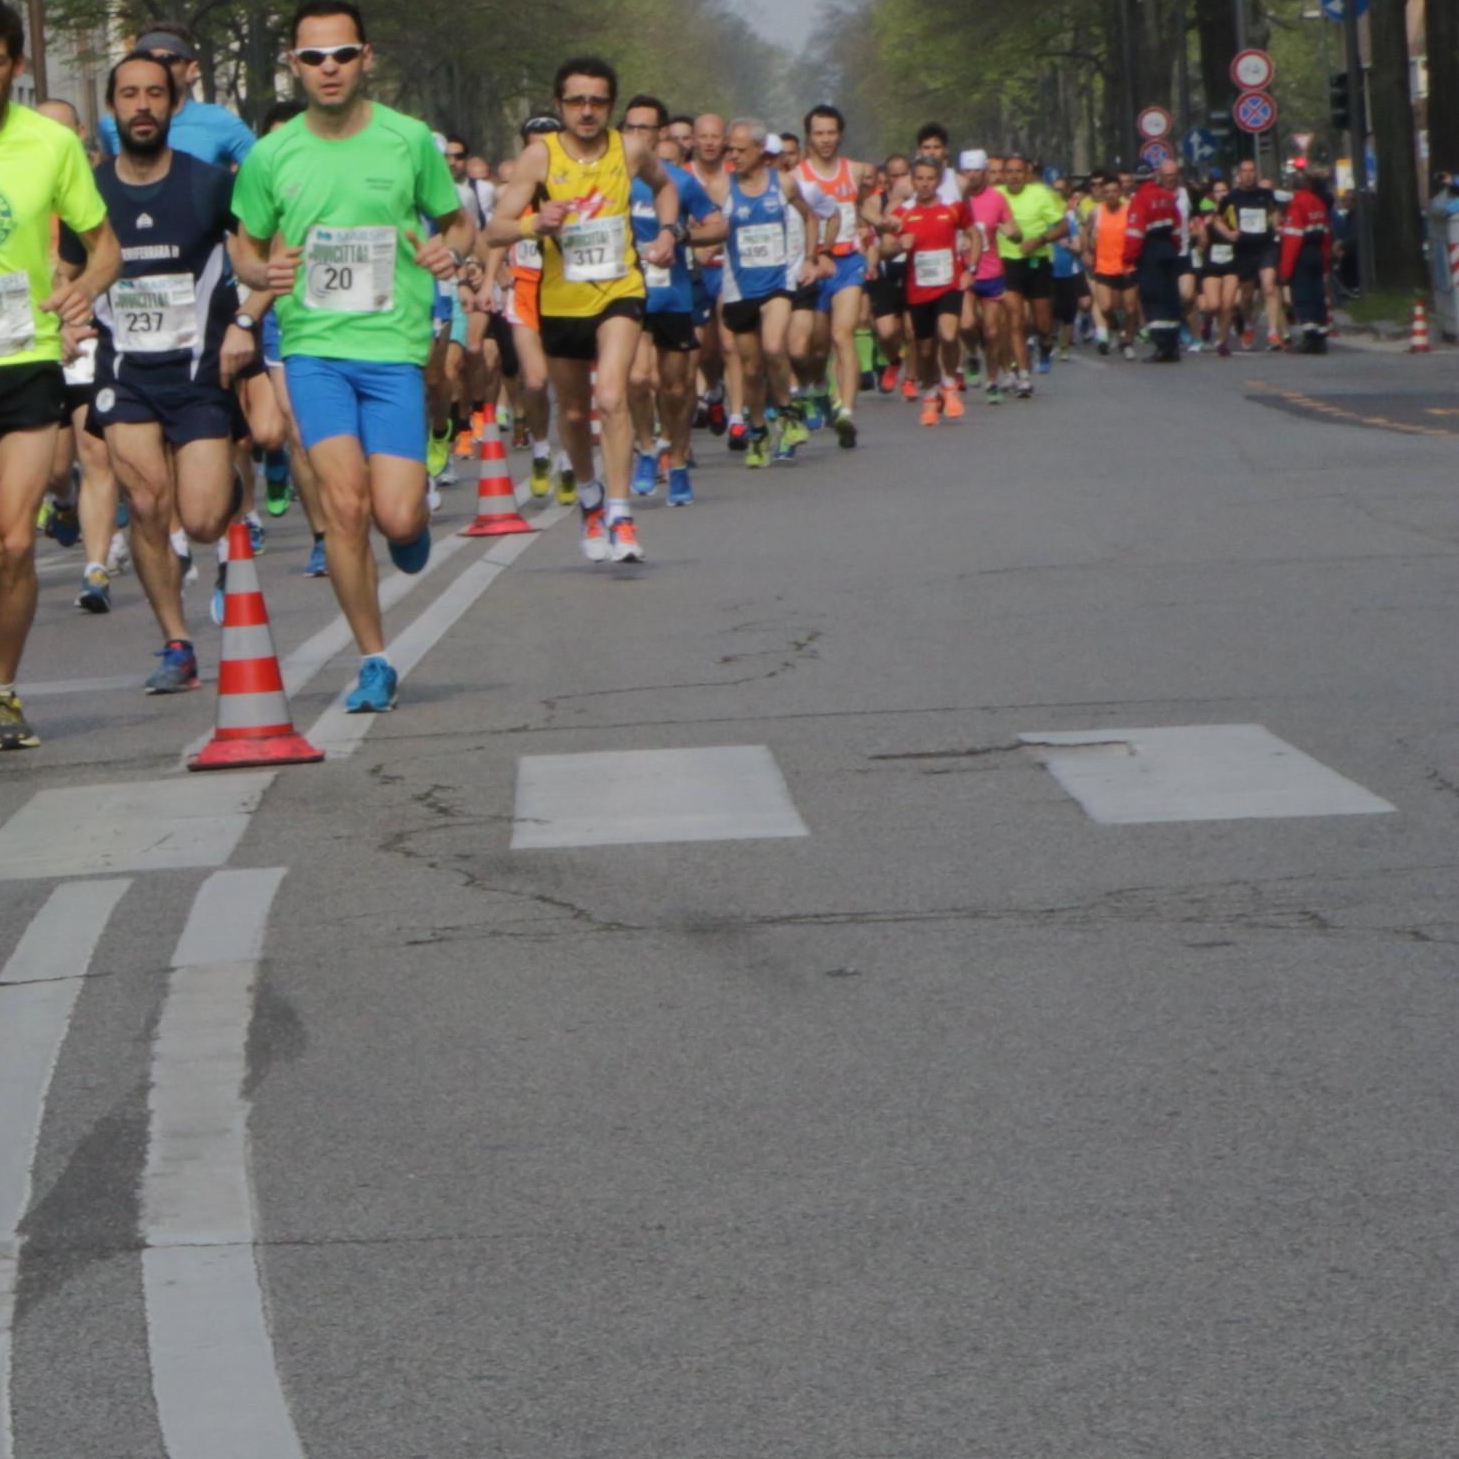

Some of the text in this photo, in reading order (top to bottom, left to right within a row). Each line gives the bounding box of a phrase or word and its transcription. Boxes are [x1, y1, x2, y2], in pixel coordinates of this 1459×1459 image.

[573, 247, 606, 267] 317
[324, 266, 354, 291] 20
[125, 311, 164, 333] 237
